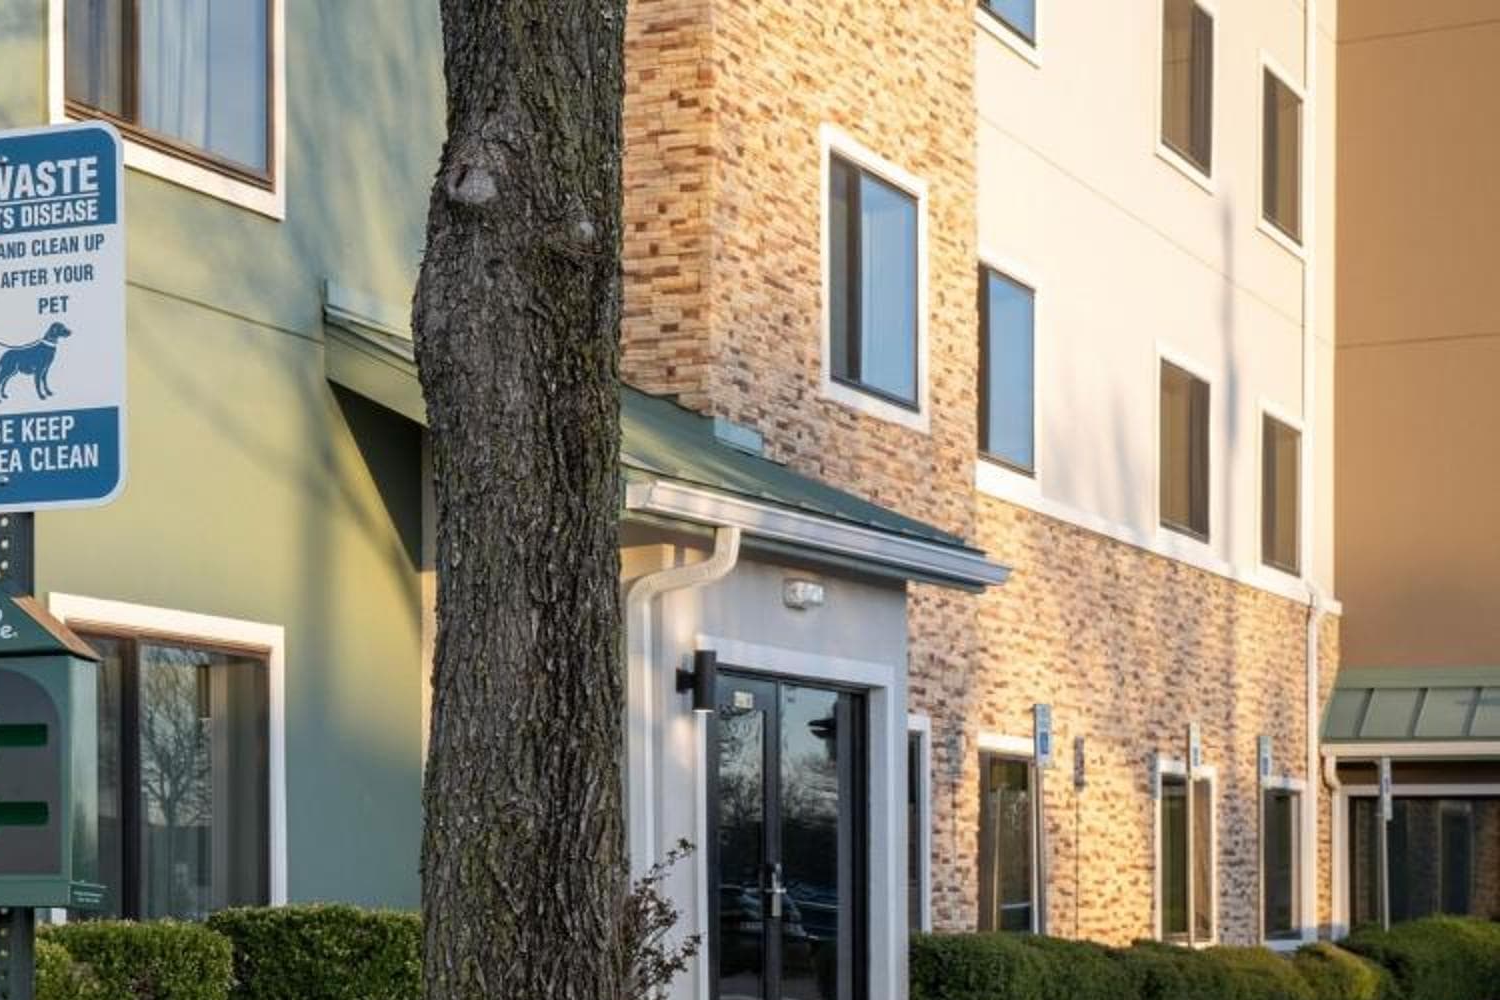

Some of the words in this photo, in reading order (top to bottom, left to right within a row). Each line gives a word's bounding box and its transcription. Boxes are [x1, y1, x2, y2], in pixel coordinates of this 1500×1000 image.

[21, 199, 98, 228] DISEASE
[31, 237, 79, 257] CLEAN
[84, 233, 105, 251] UP
[0, 269, 47, 288] AFTER
[53, 264, 93, 283] YOUR
[38, 295, 69, 314] PET
[21, 416, 75, 442] KEEP
[30, 444, 99, 471] CLEAN
